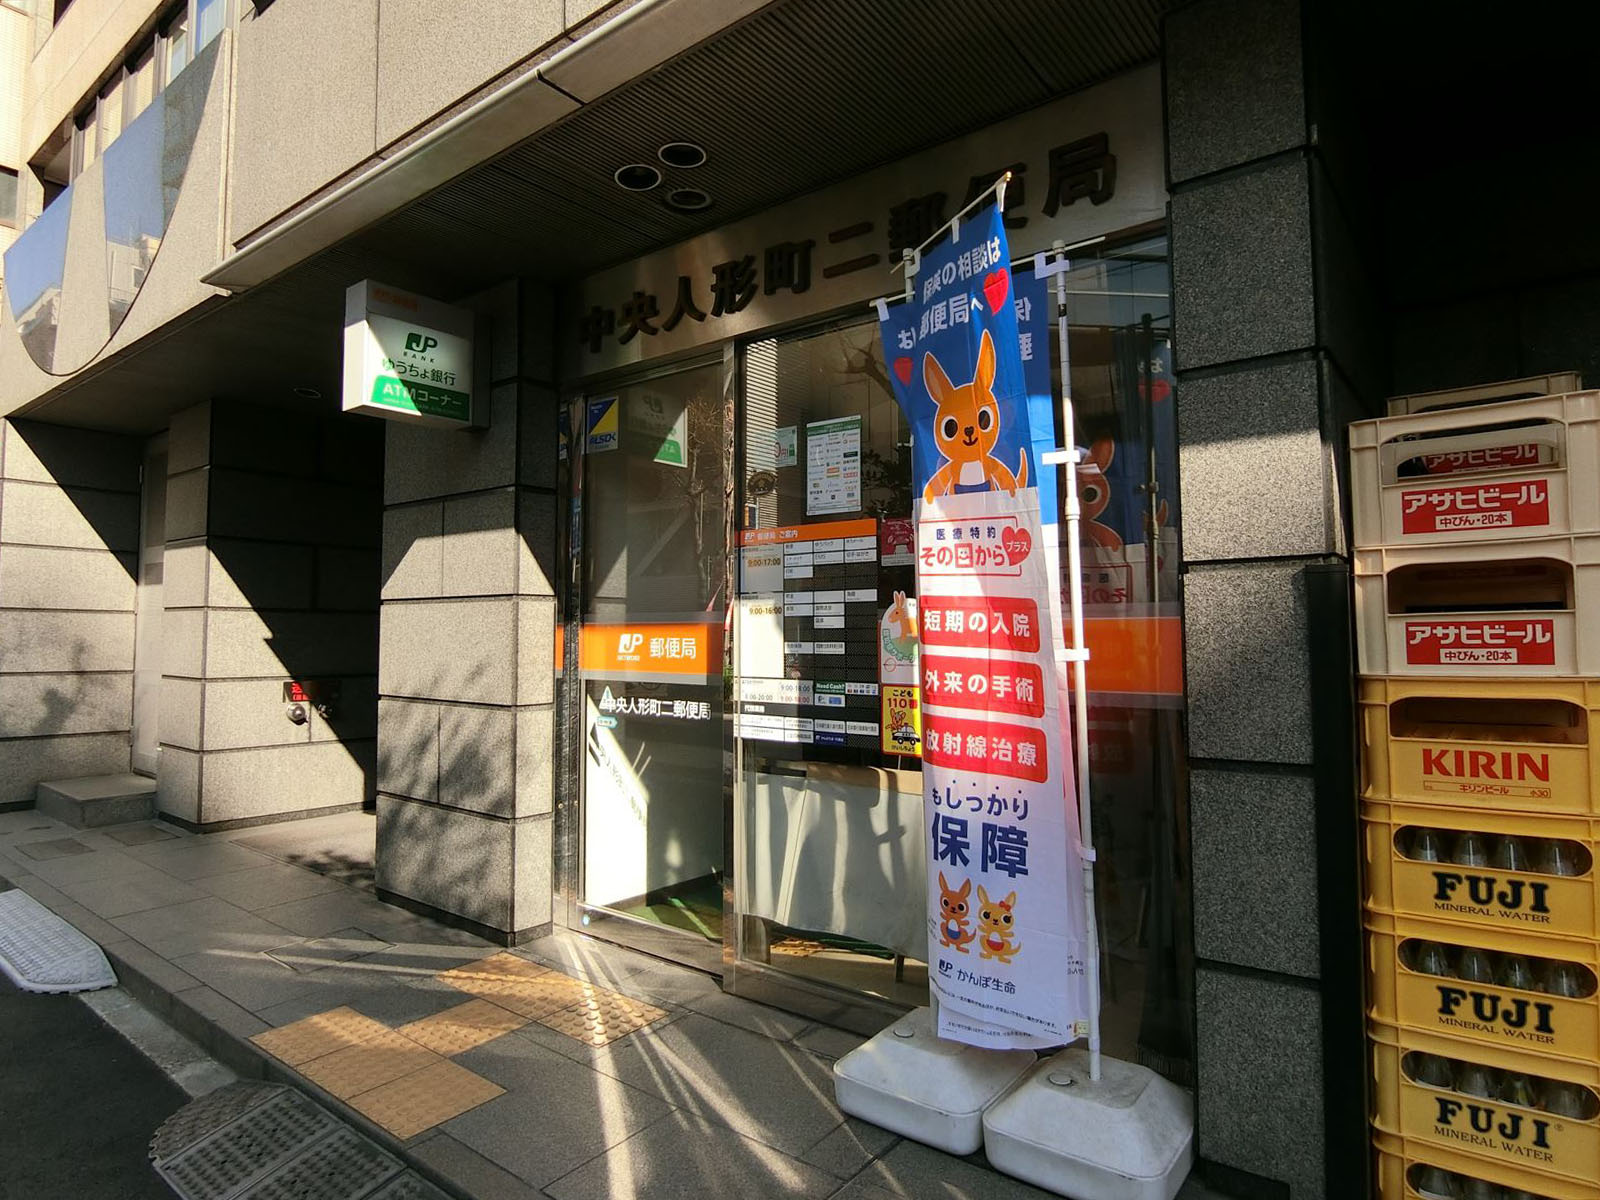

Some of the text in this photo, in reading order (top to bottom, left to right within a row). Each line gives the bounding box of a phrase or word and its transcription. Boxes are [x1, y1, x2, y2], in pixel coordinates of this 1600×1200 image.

[403, 351, 435, 363] BANK
[382, 358, 456, 386] ゆうちょ銀行
[383, 383, 462, 406] ATMコーナー
[1404, 485, 1546, 514] アサヒビール
[936, 526, 997, 540] 医療特約
[924, 610, 1031, 638] 短期の入院
[1408, 624, 1551, 645] アサヒビール
[649, 637, 697, 660] 郵便局
[893, 689, 914, 698] こども
[925, 669, 1035, 702] 外来の手術
[606, 697, 711, 720] 中央人形町二郵便局
[926, 728, 1037, 767] 放射線治療
[1422, 748, 1549, 782] KIRIN
[932, 812, 1029, 879] 保障
[1432, 871, 1550, 913] FUJI
[1434, 902, 1551, 924] MINERAL WATER
[957, 969, 1016, 995] かんぽ生命
[1436, 985, 1554, 1034] FUJI
[1438, 1016, 1555, 1044] MINERAL WATER
[1435, 1097, 1550, 1149] FUJI
[1434, 1125, 1554, 1163] MINERAL WATER
